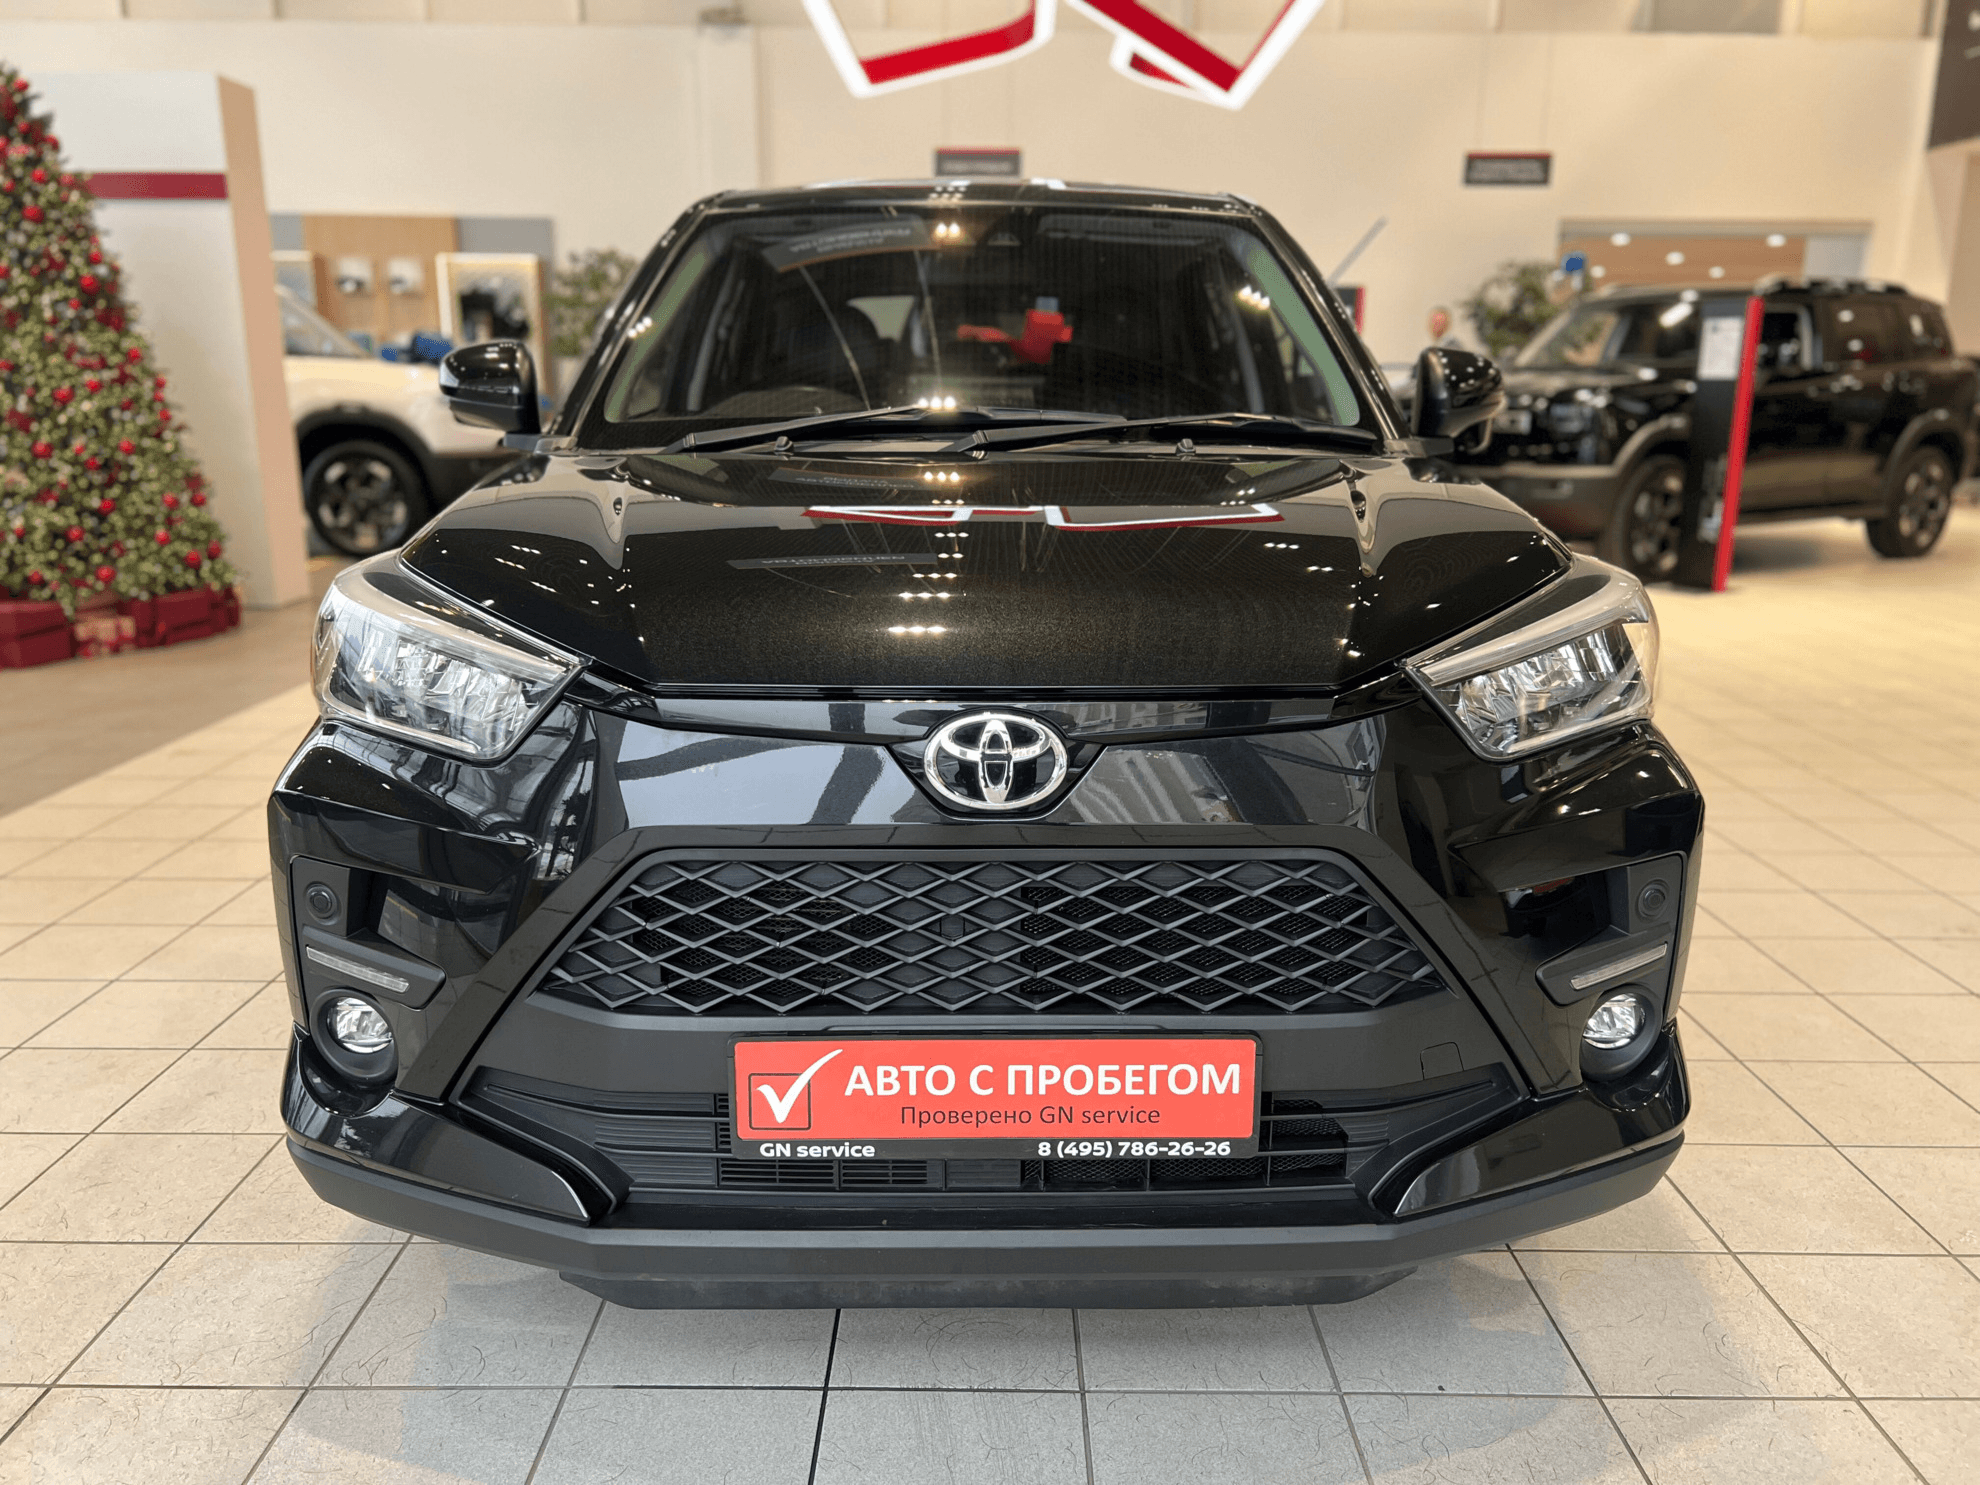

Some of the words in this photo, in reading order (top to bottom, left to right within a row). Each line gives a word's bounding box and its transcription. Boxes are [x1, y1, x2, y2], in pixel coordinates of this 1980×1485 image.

[844, 1064, 956, 1096] АВТО
[969, 1064, 994, 1096] С
[1007, 1063, 1240, 1096] ПРОБЕГОМ
[901, 1106, 1032, 1129] Проверено
[1039, 1105, 1073, 1124] GN
[1081, 1105, 1161, 1124] service
[759, 1142, 792, 1158] GN
[796, 1141, 876, 1158] service
[1037, 1141, 1052, 1157] 8
[1056, 1140, 1113, 1159] (495)
[1117, 1140, 1231, 1157] 786-26-26
